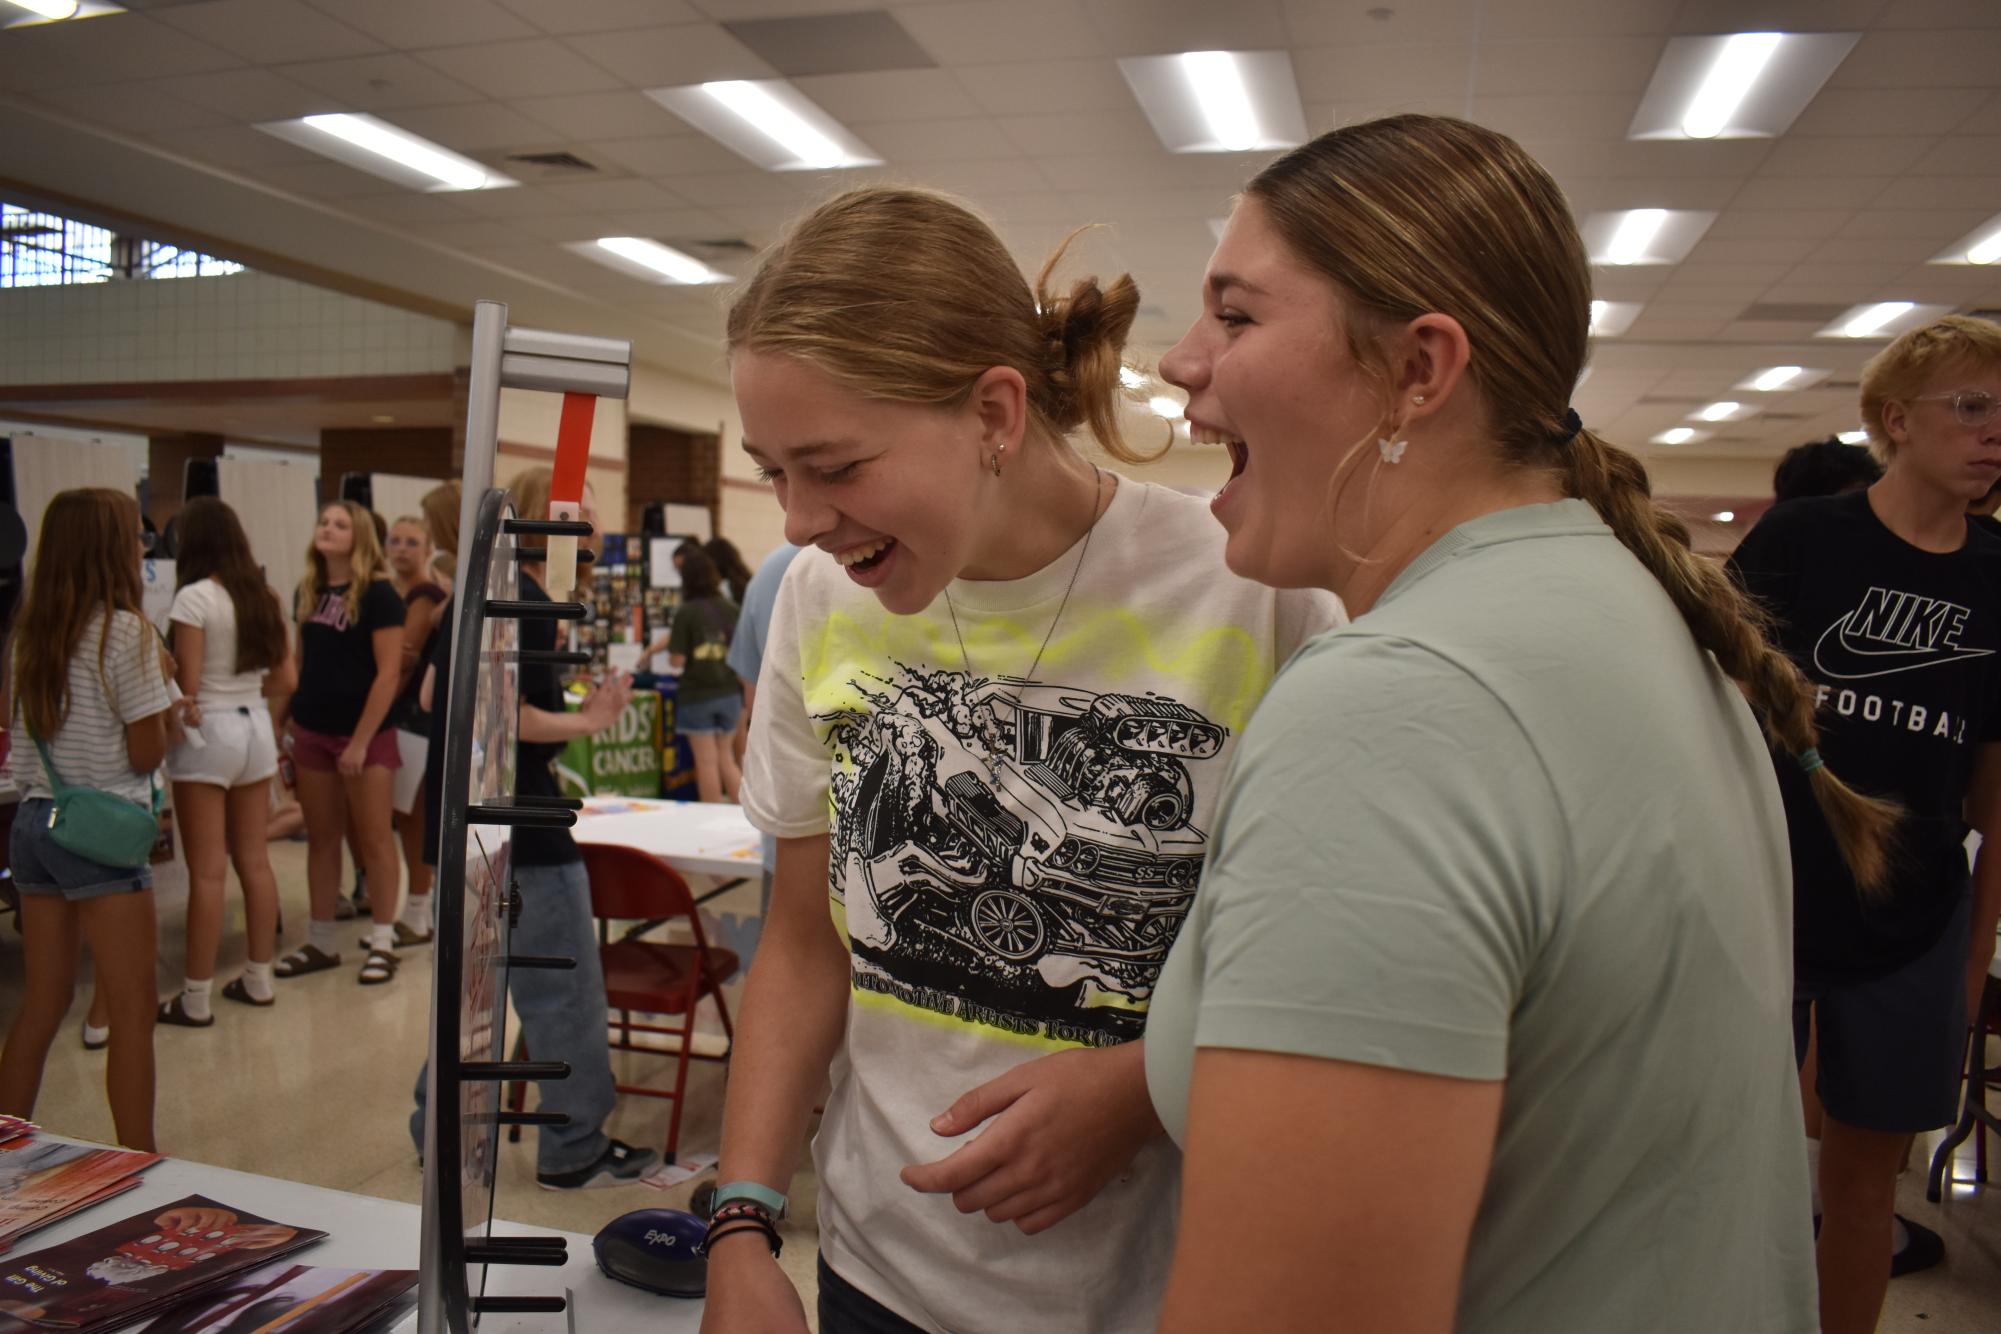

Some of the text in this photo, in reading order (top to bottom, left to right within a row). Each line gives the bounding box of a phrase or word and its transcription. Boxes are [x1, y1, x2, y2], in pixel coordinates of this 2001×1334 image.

[1845, 587, 1971, 651] NIKE
[1135, 866, 1156, 879] SS
[644, 1229, 676, 1246] EXPO
[25, 1265, 57, 1281] Giving
